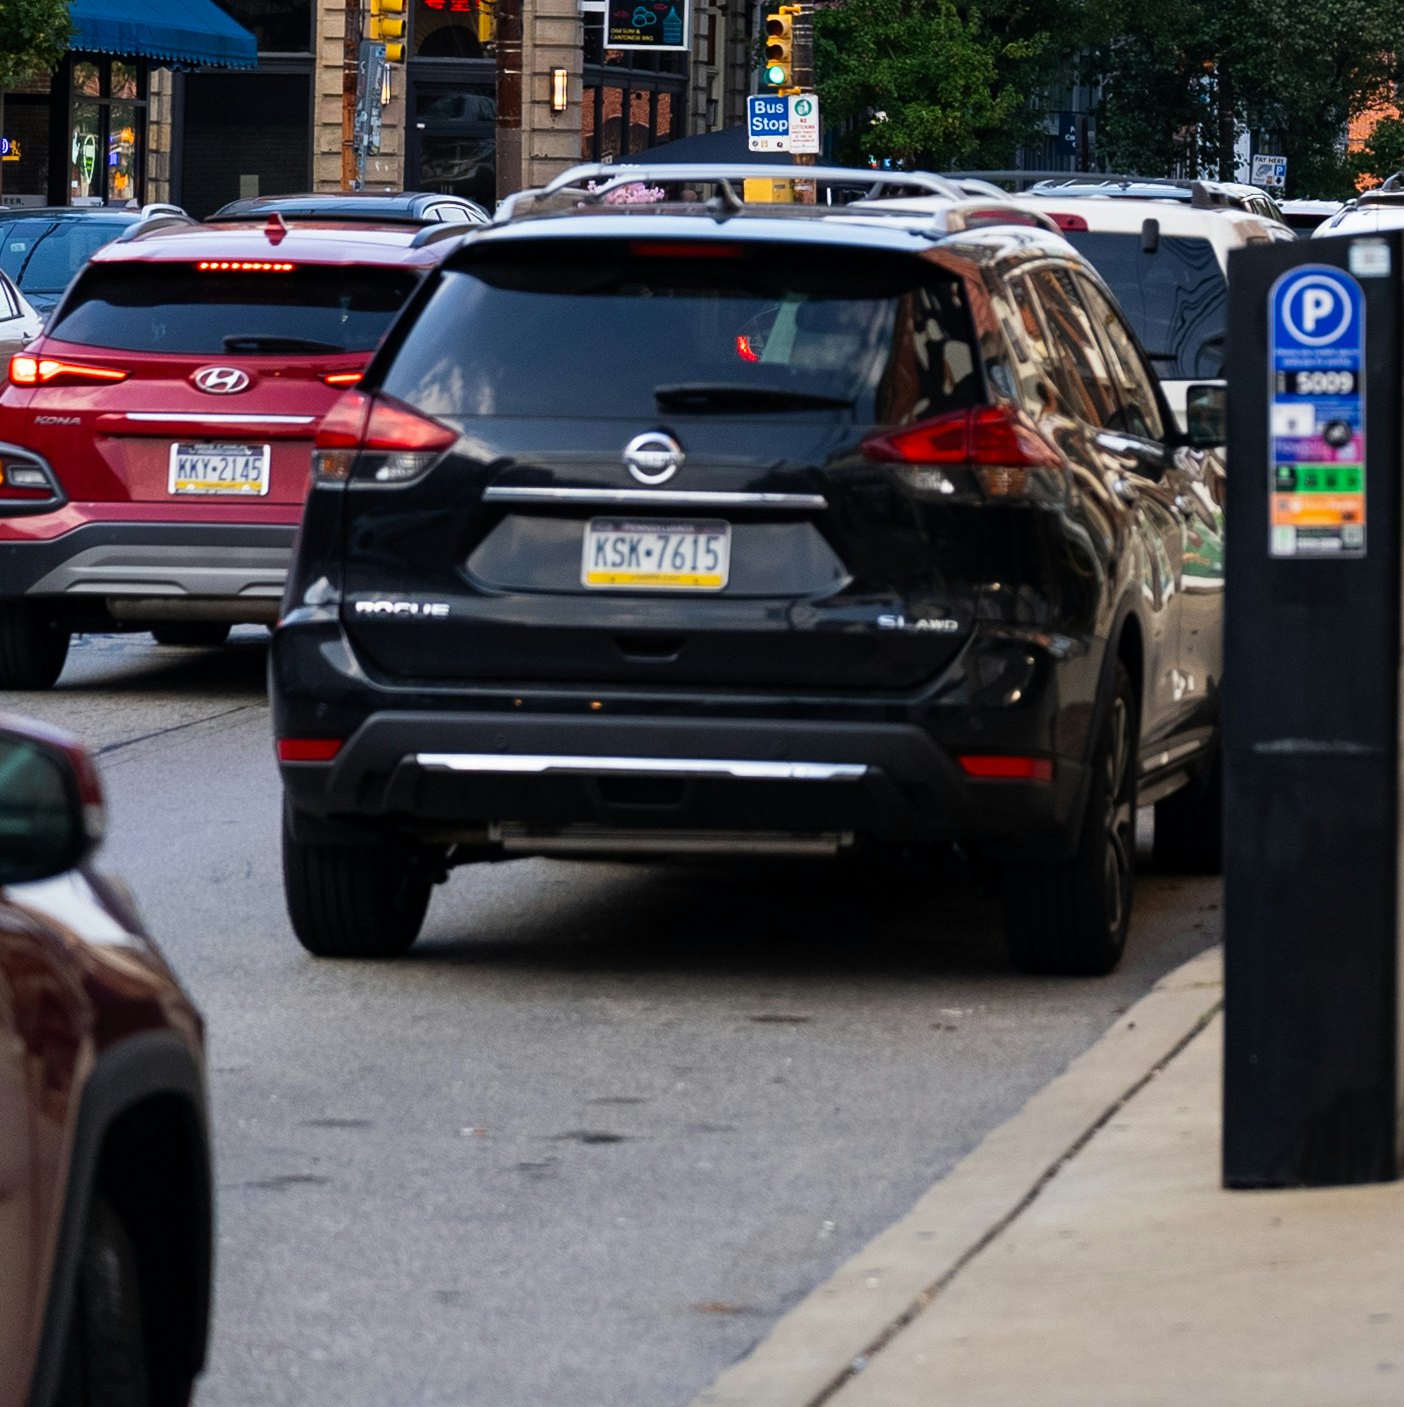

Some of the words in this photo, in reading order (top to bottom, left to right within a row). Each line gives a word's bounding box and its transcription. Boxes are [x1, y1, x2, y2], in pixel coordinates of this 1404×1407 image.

[754, 100, 784, 114] Bus
[752, 117, 788, 132] Stop
[1302, 288, 1335, 333] P
[1296, 371, 1354, 395] 5009
[33, 415, 82, 425] KONA
[916, 618, 959, 632] AWD
